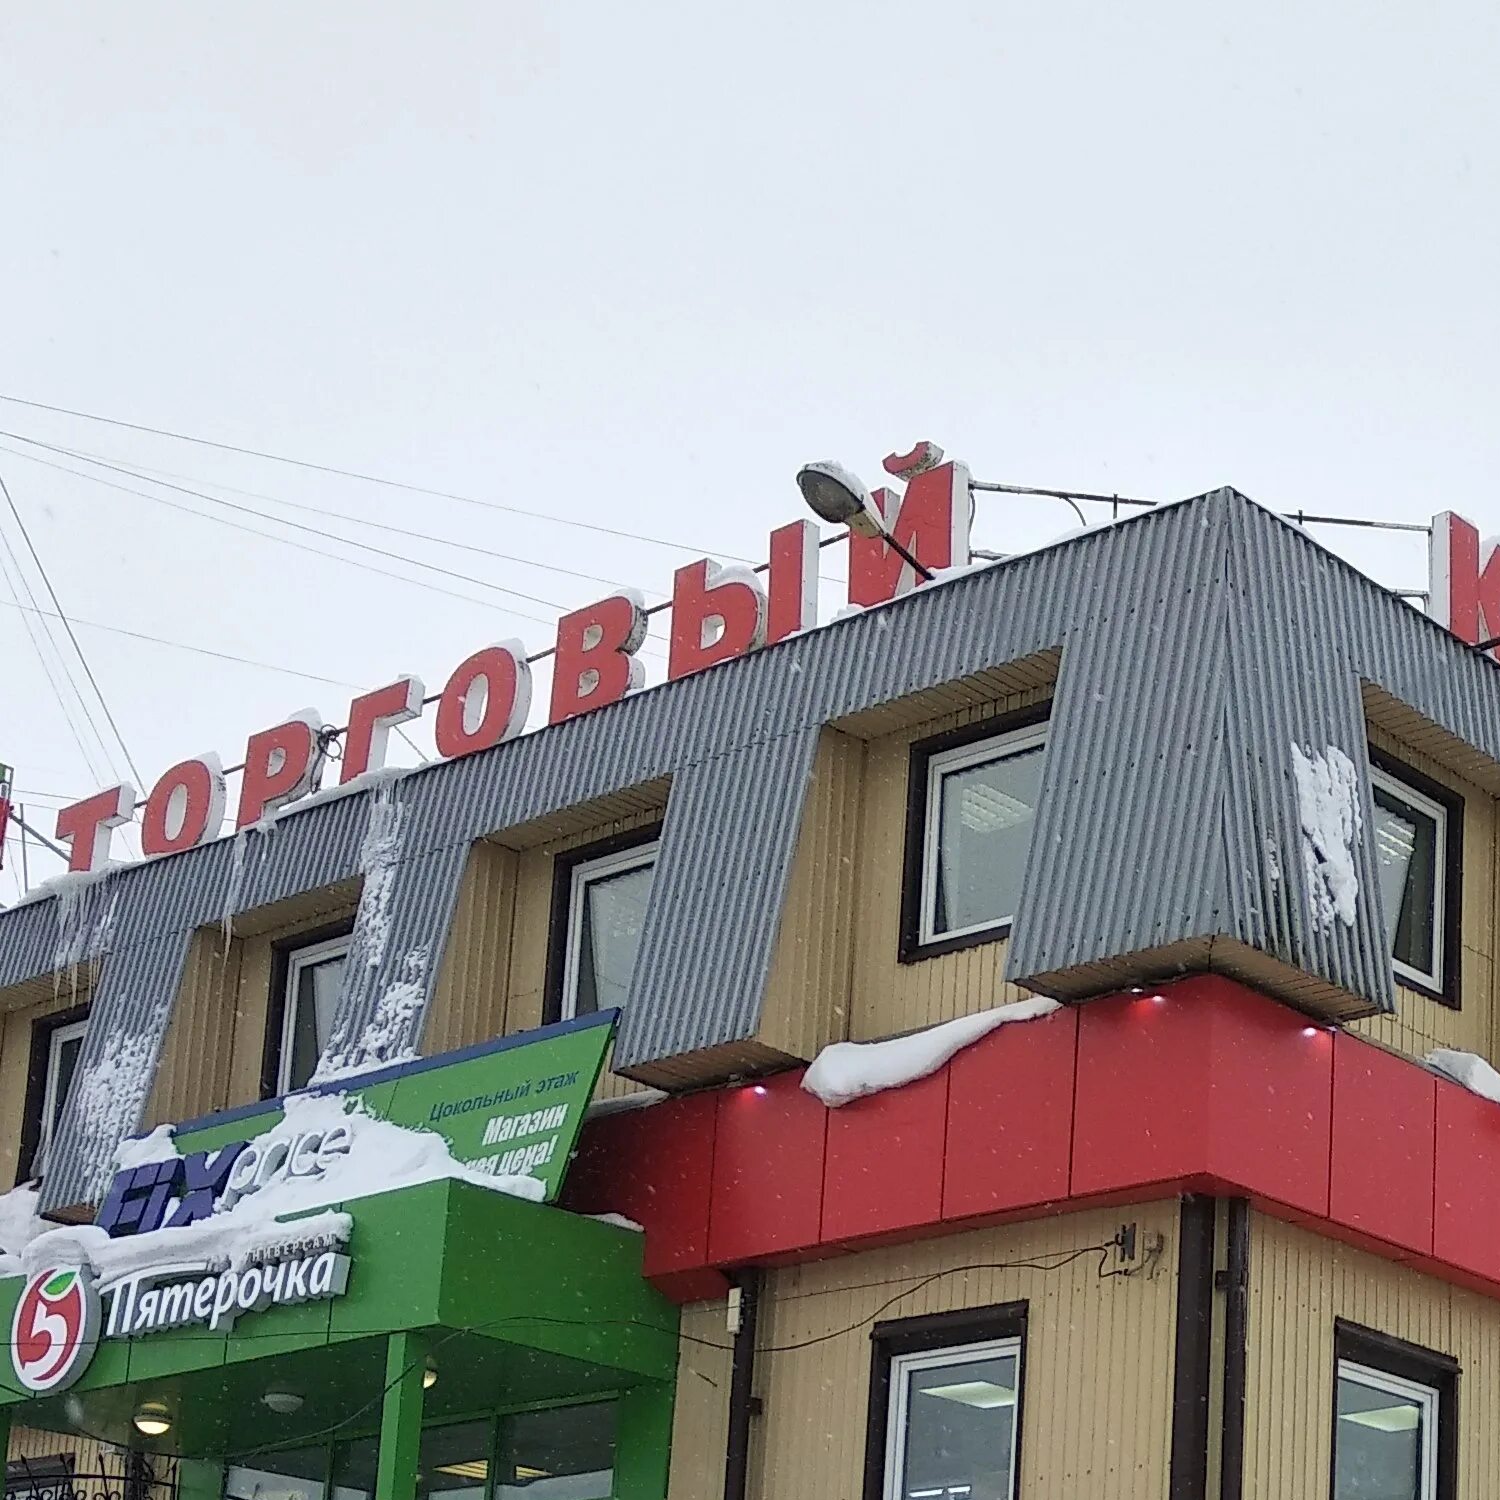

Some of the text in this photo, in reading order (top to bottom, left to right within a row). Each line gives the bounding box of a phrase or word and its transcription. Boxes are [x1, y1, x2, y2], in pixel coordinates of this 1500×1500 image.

[56, 440, 968, 872] ТОРГОВЫЙ
[429, 1070, 580, 1122] Цокольный этаж
[482, 1103, 569, 1146] Магазин
[497, 1133, 559, 1175] цена!
